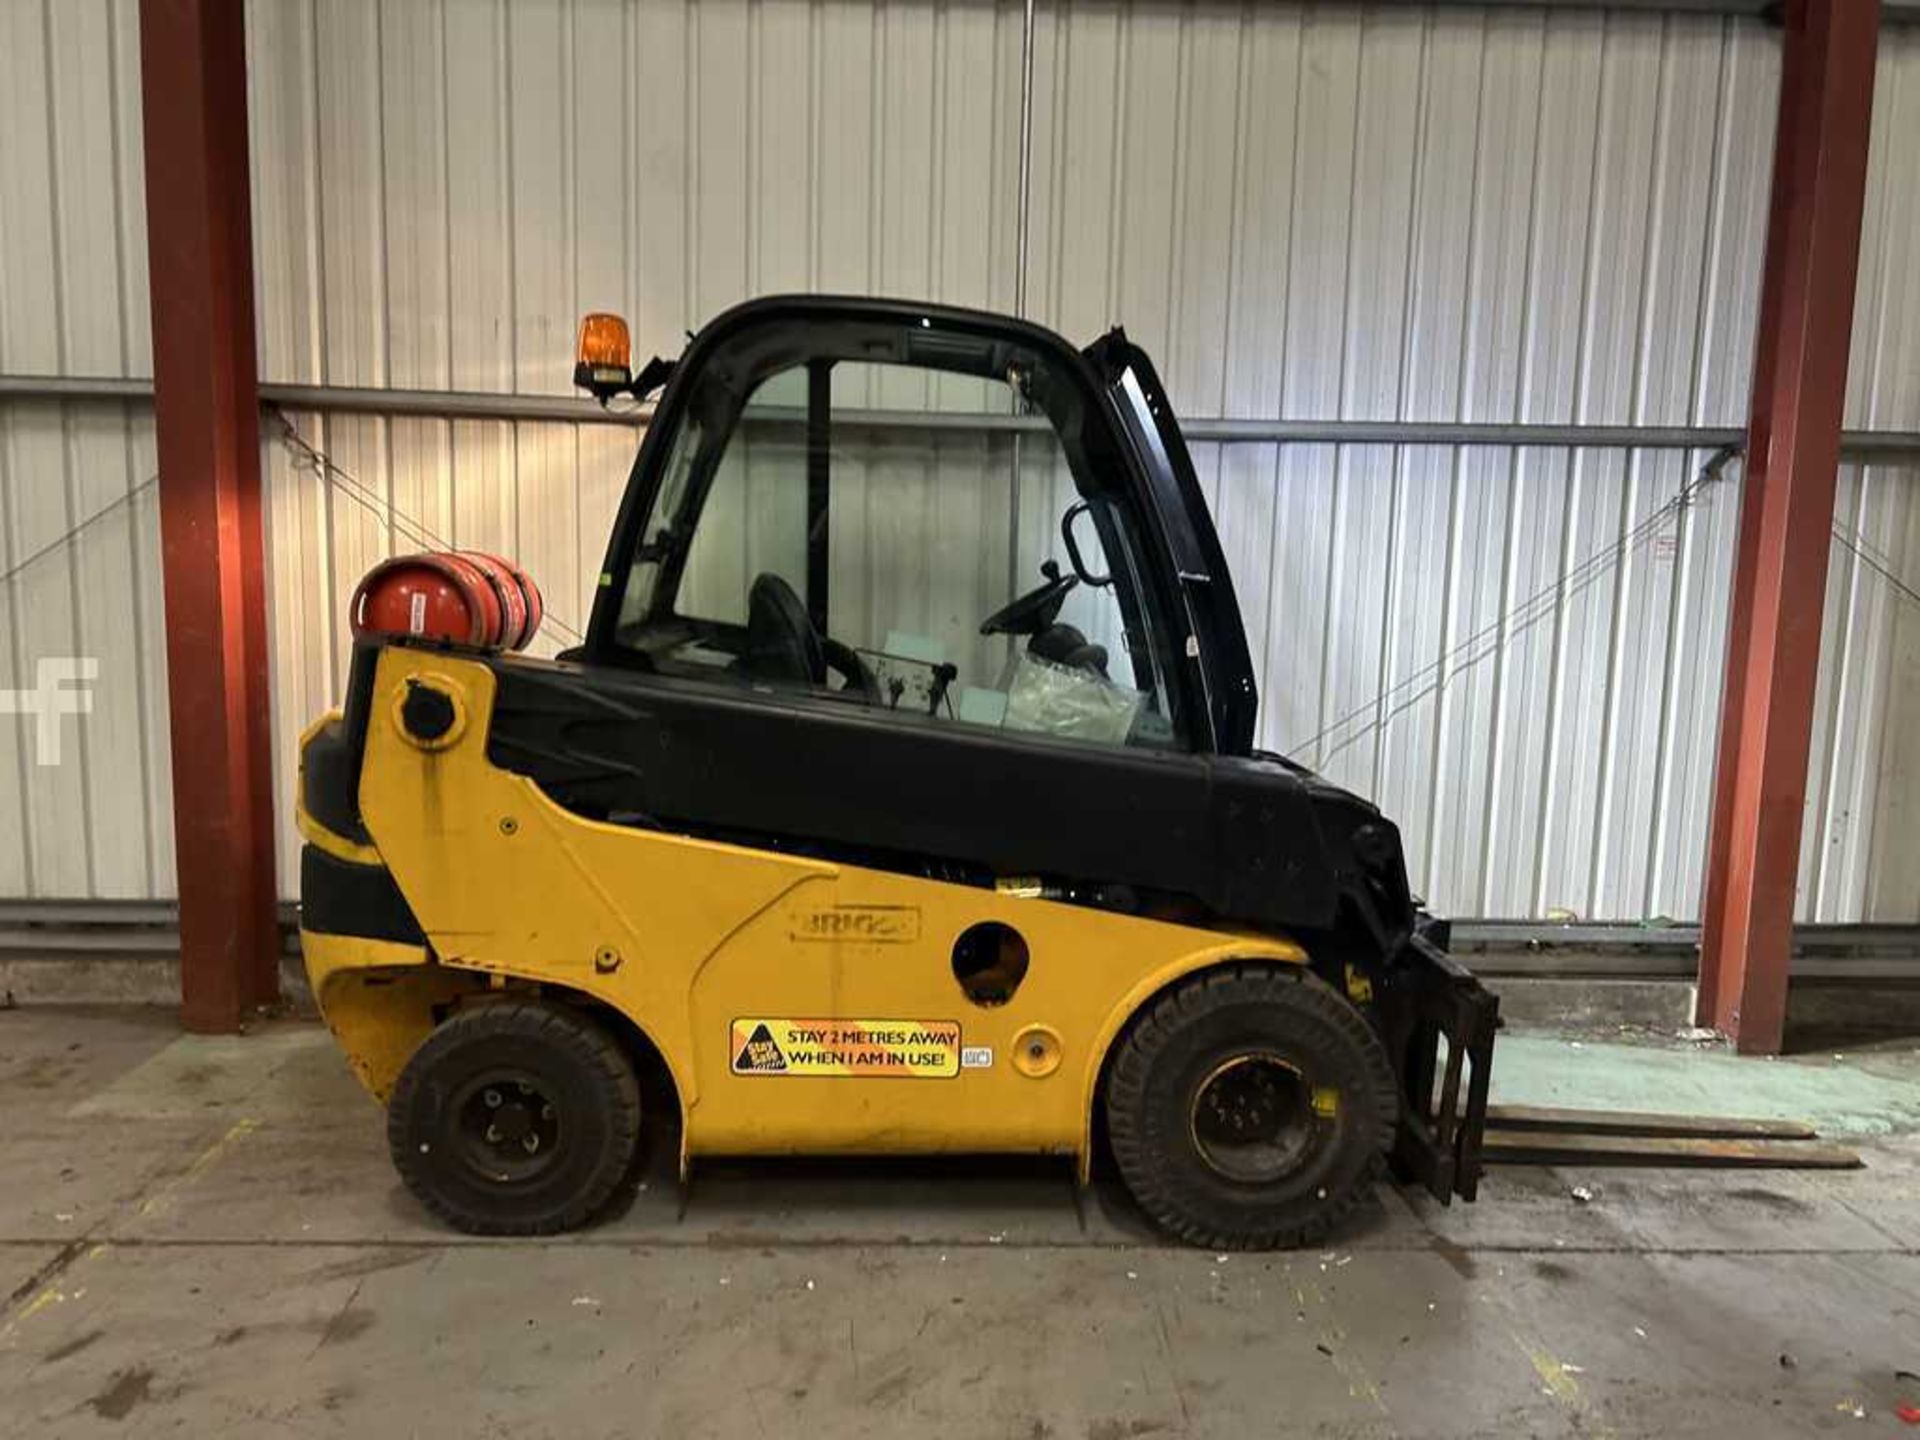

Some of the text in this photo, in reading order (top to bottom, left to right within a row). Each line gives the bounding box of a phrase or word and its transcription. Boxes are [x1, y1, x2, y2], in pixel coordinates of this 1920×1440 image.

[787, 1030, 957, 1046] STAY 2 METRES AWAY
[788, 1051, 845, 1065] WHEN
[848, 1052, 853, 1065] I
[856, 1052, 884, 1065] AM
[886, 1052, 905, 1065] IN
[908, 1053, 946, 1066] USE!
